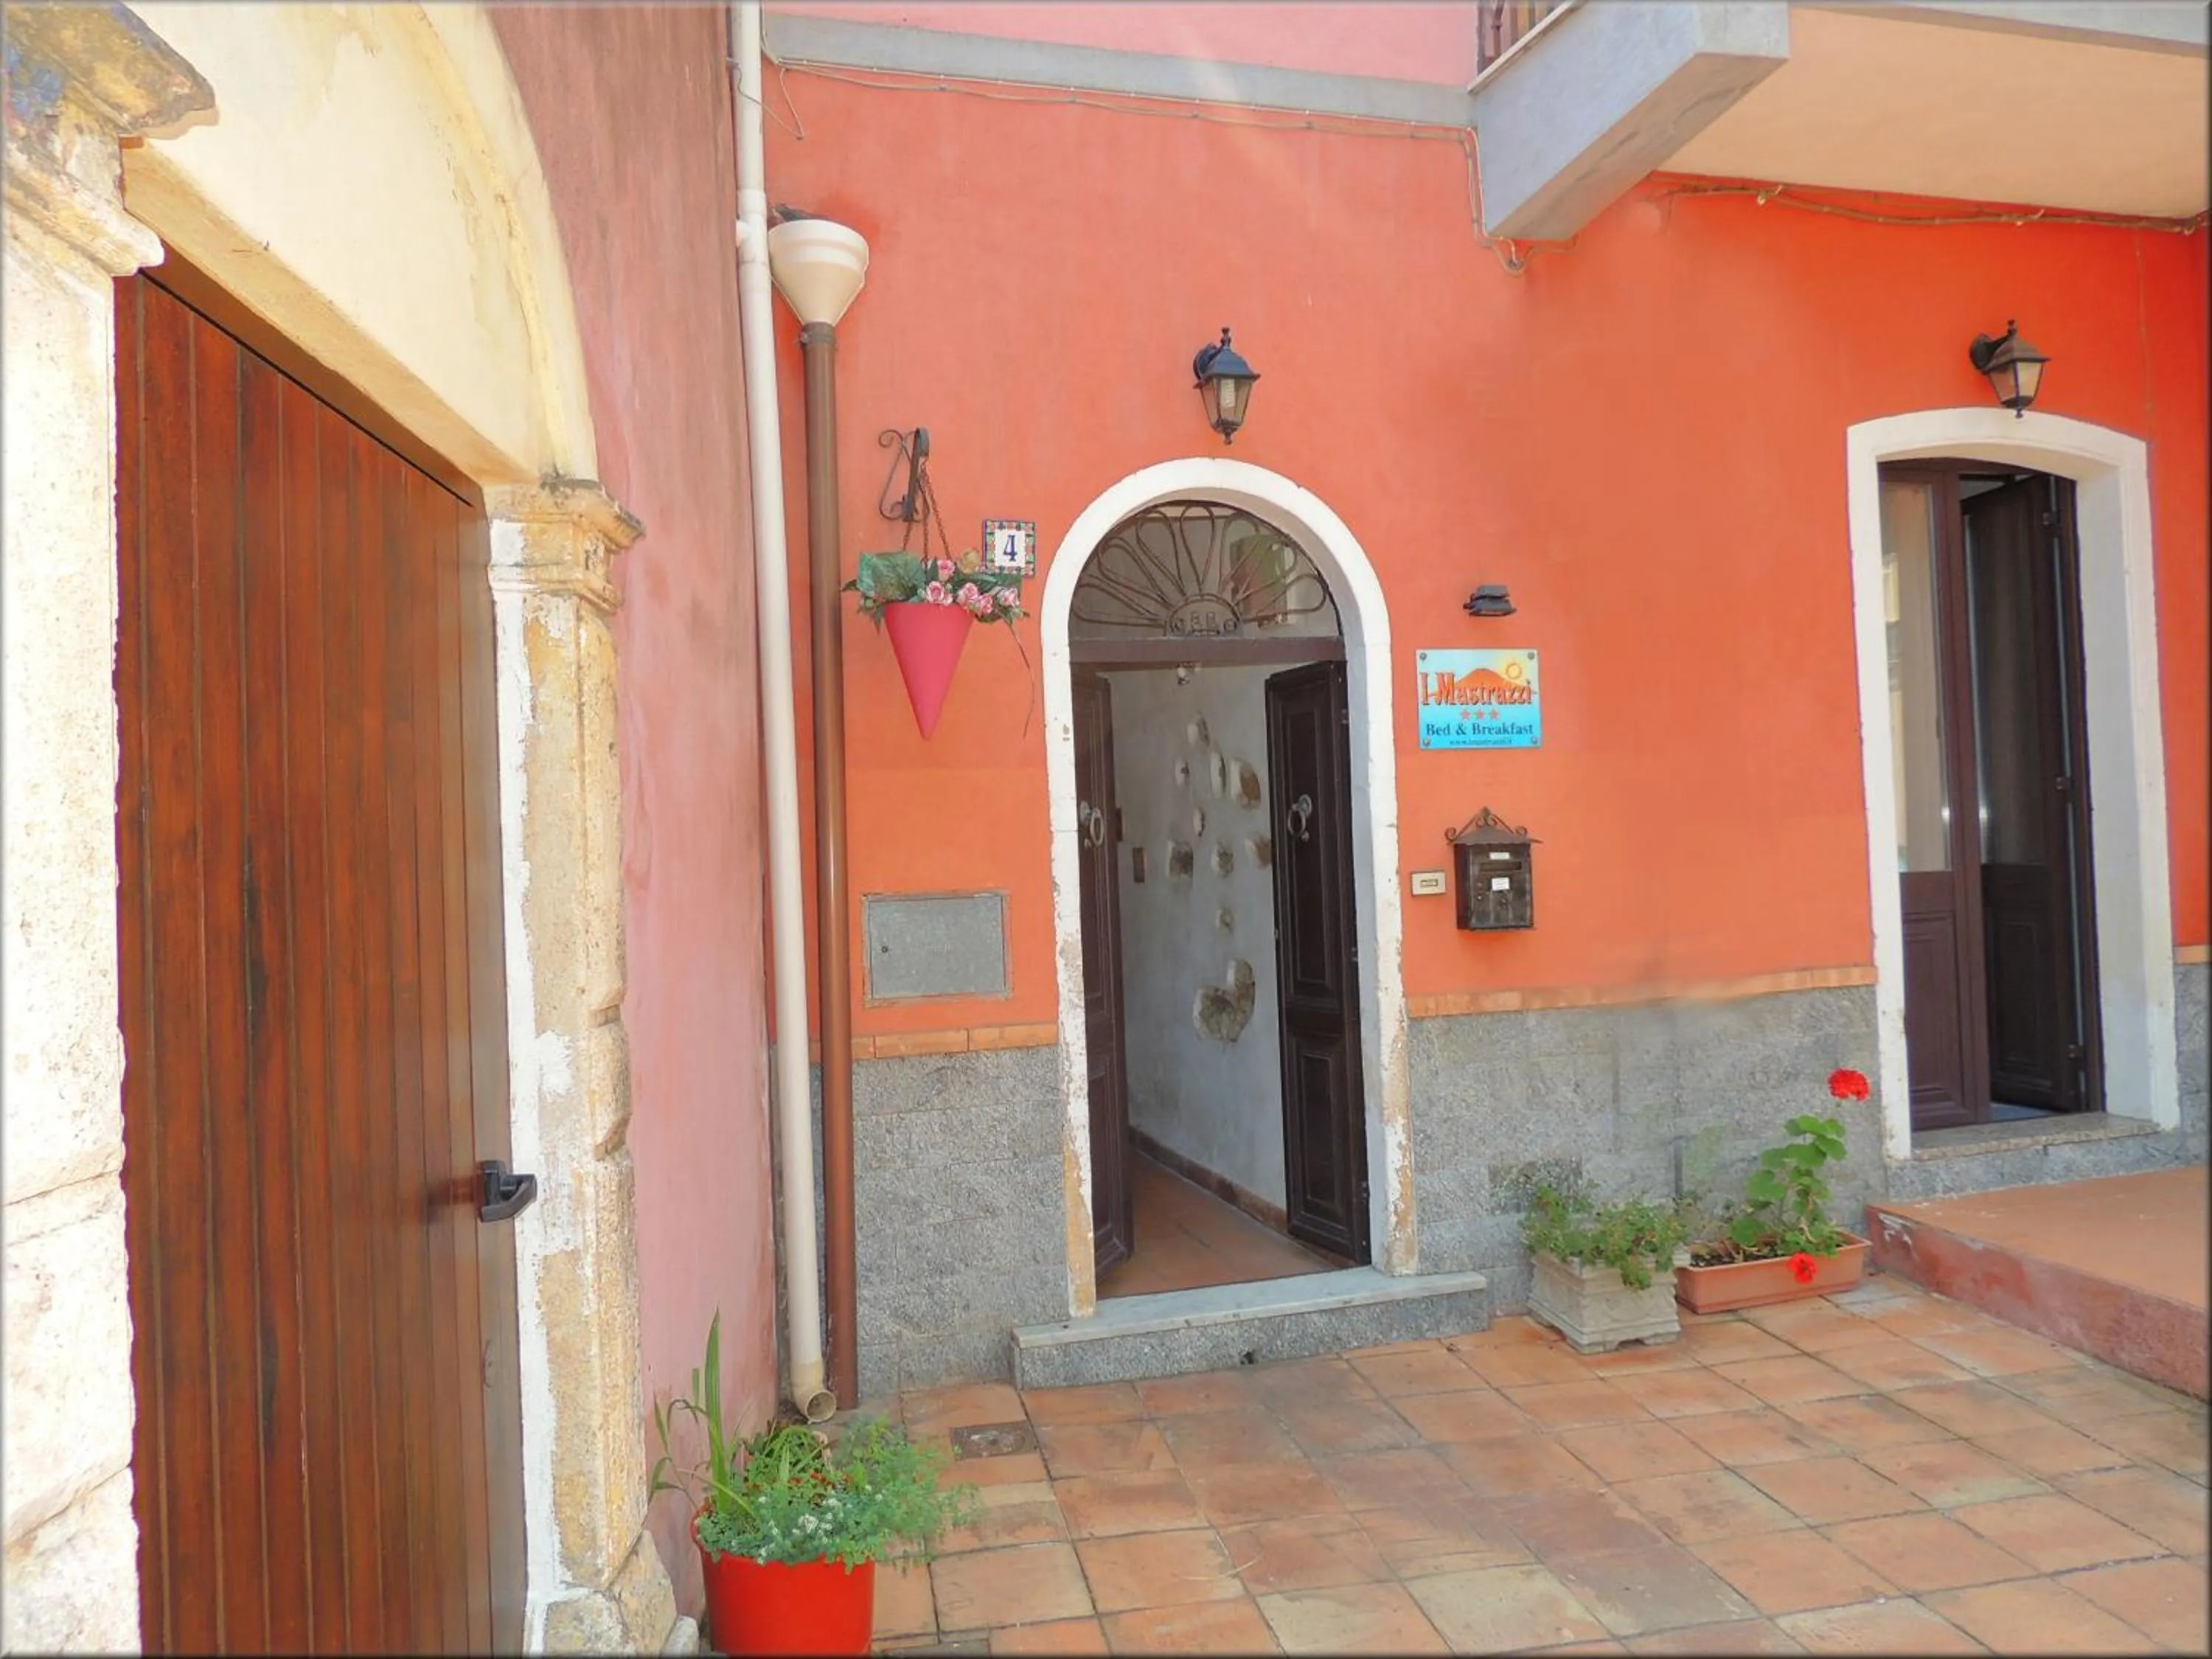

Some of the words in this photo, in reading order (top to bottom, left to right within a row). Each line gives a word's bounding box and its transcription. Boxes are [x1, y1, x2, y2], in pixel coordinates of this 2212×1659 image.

[1003, 535, 1018, 562] 4
[1426, 723, 1450, 736] Bed
[1455, 723, 1467, 736] &
[1472, 721, 1534, 736] Breakfast
